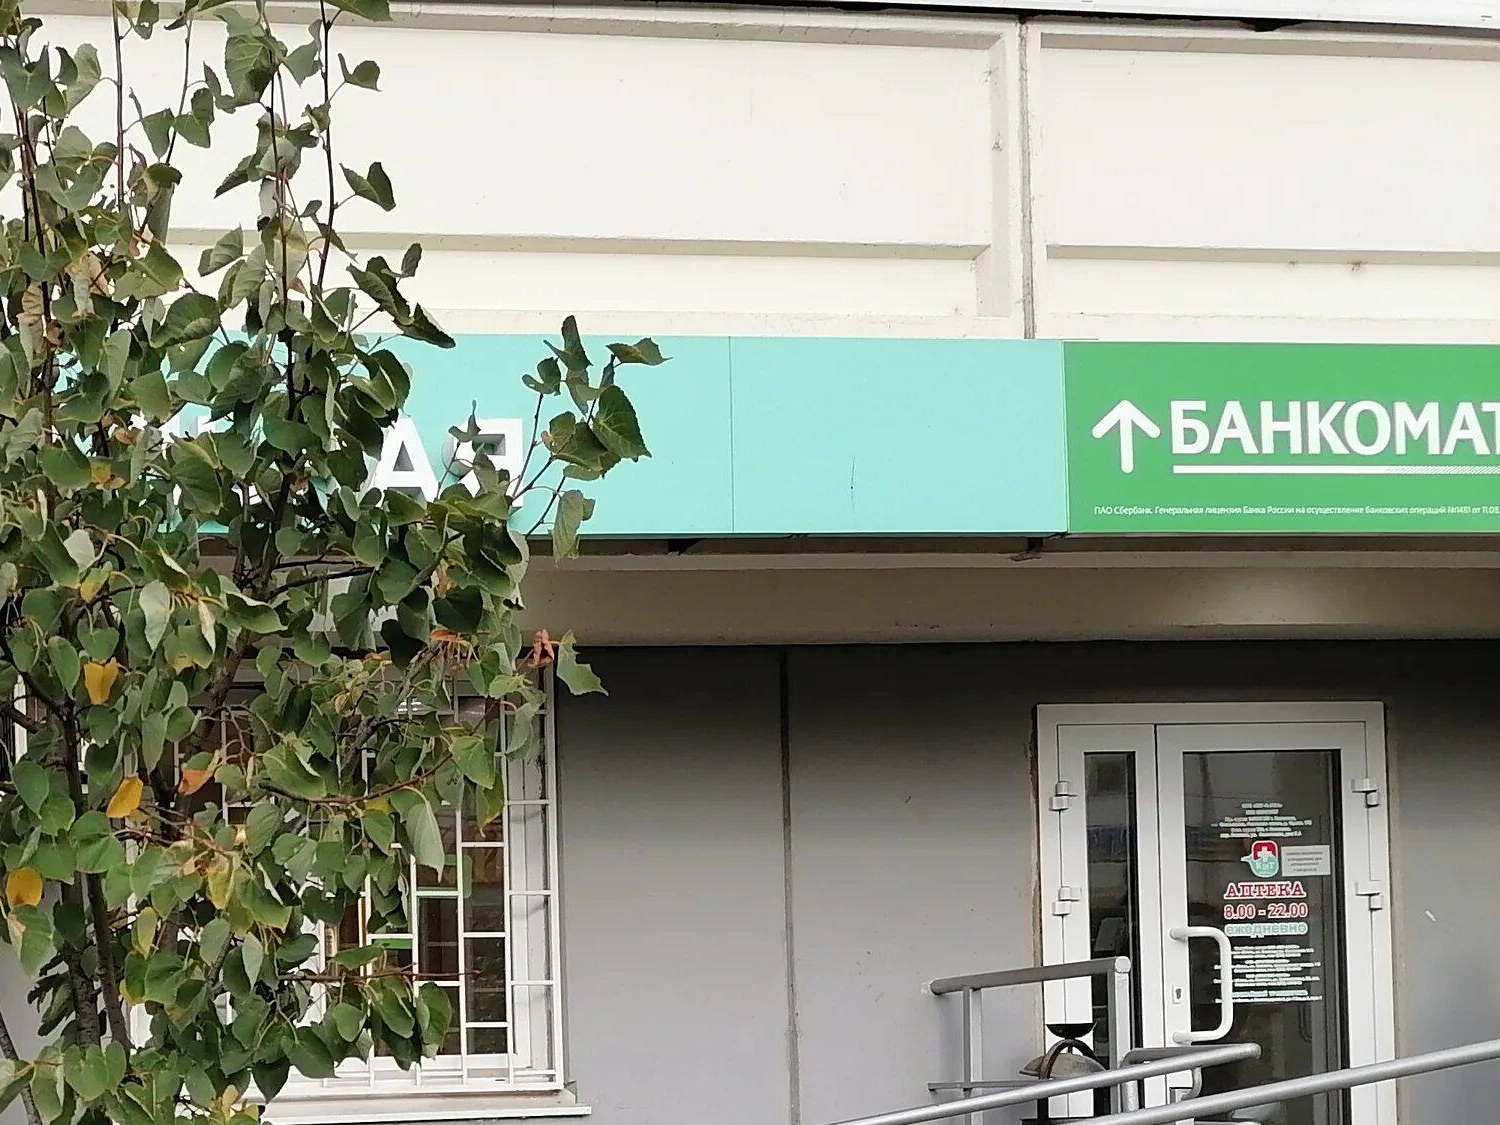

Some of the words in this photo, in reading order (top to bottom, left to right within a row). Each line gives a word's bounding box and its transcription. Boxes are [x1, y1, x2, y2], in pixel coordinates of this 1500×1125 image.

[1094, 506, 1112, 515] ПАО
[1155, 506, 1204, 516] Генеральная
[1205, 507, 1242, 515] лицензия
[1267, 505, 1295, 514] России
[1306, 506, 1364, 516] осуществление
[1409, 506, 1446, 516] операций
[1225, 882, 1305, 898] АПТЕКА
[1225, 905, 1255, 918] 8.00
[1268, 904, 1308, 918] 22.00
[1225, 923, 1307, 937] ежедневно
